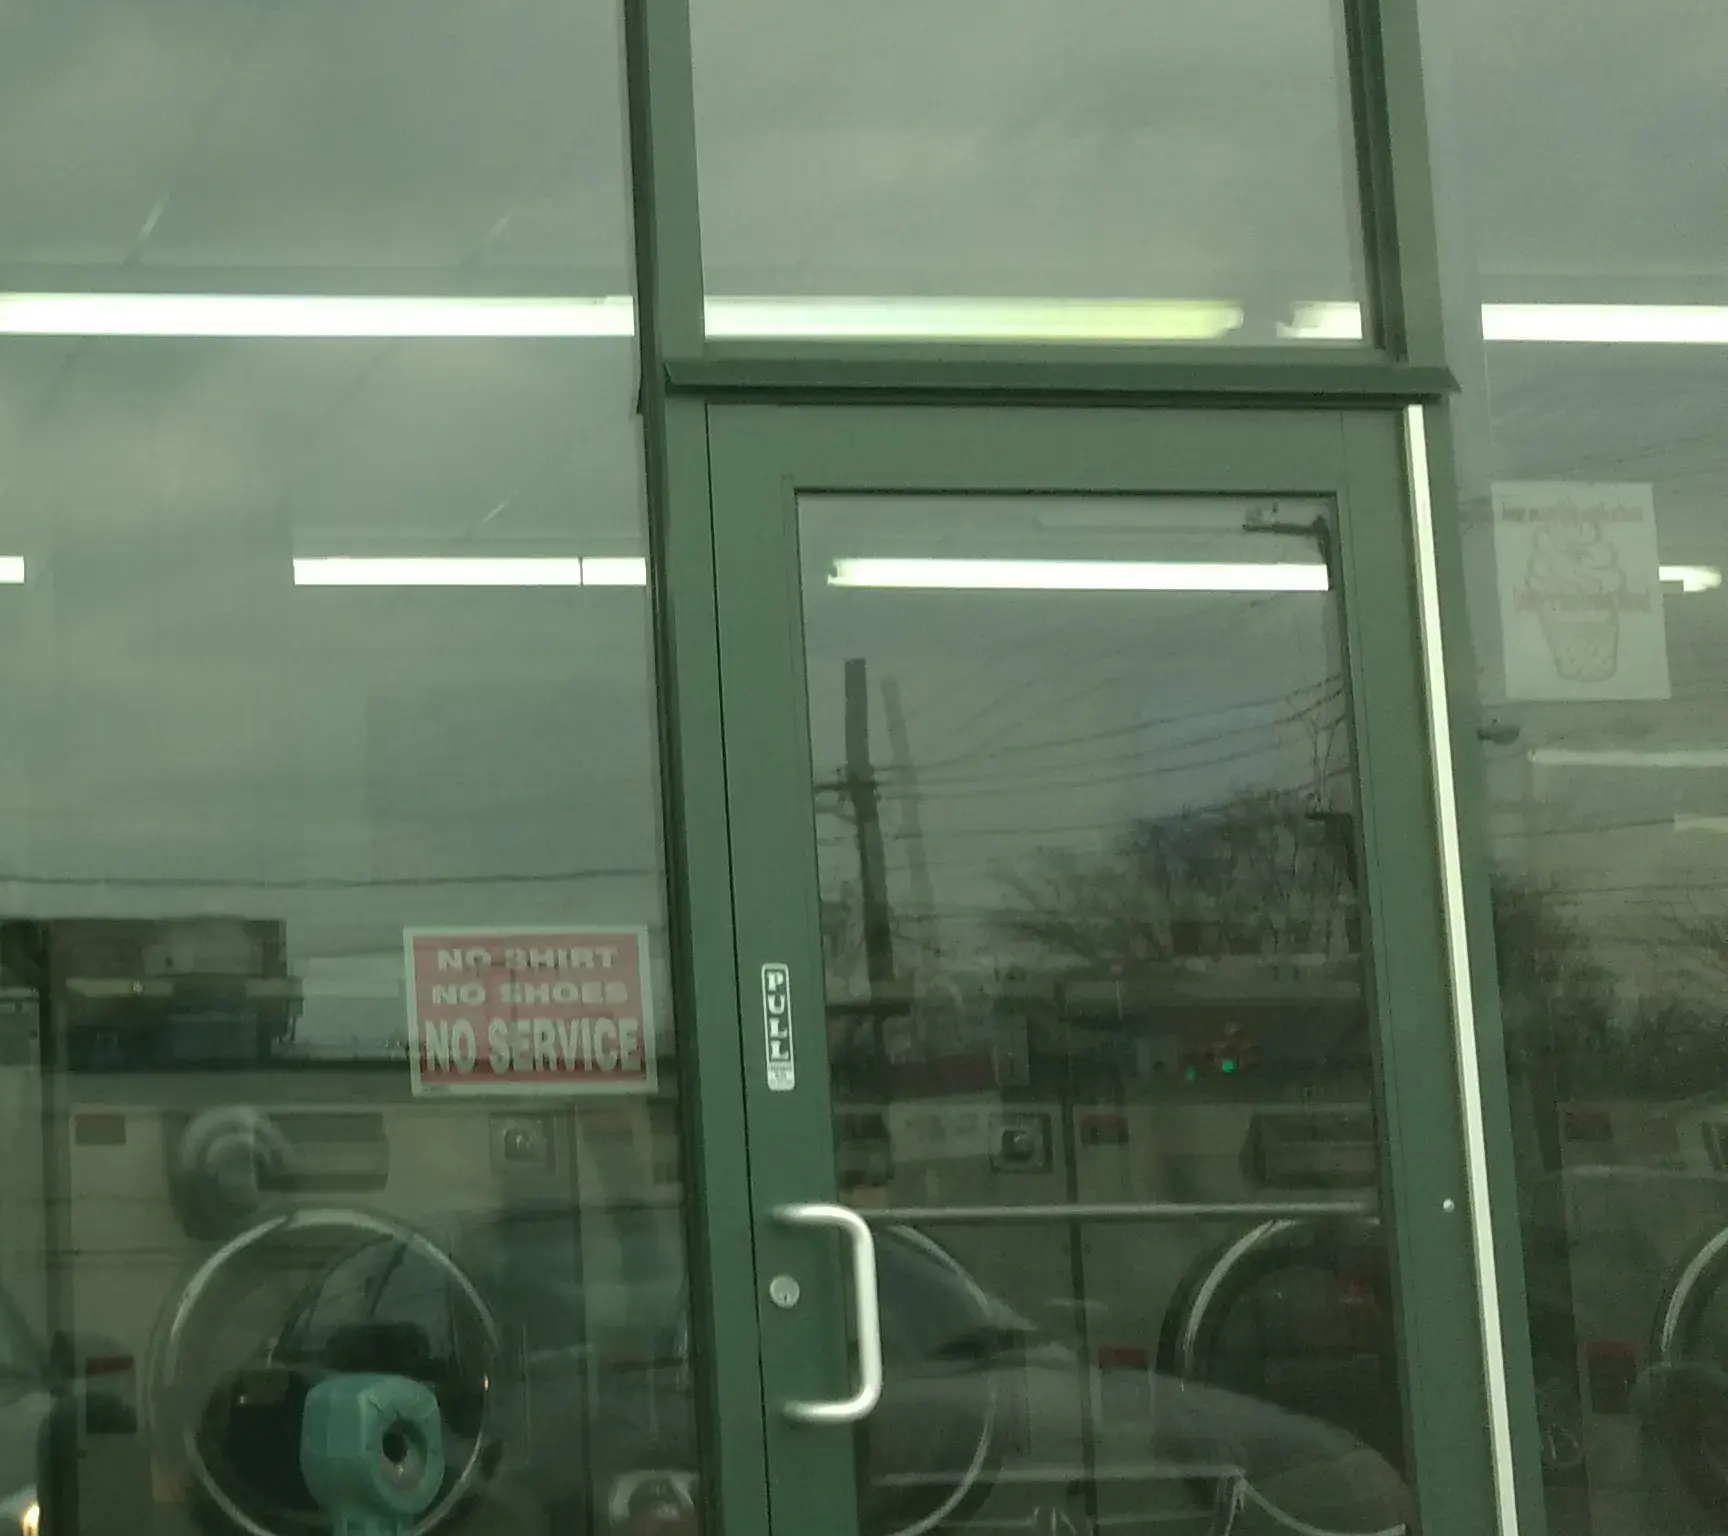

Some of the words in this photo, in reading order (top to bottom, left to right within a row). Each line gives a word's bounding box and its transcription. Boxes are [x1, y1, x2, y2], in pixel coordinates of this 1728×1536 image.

[438, 948, 491, 970] NO
[505, 947, 619, 970] SHIRT
[432, 982, 486, 1005] NO
[499, 981, 628, 1004] SHOES
[766, 971, 789, 1060] PULL
[425, 1018, 477, 1073] NO
[488, 1017, 642, 1074] SERVICE
